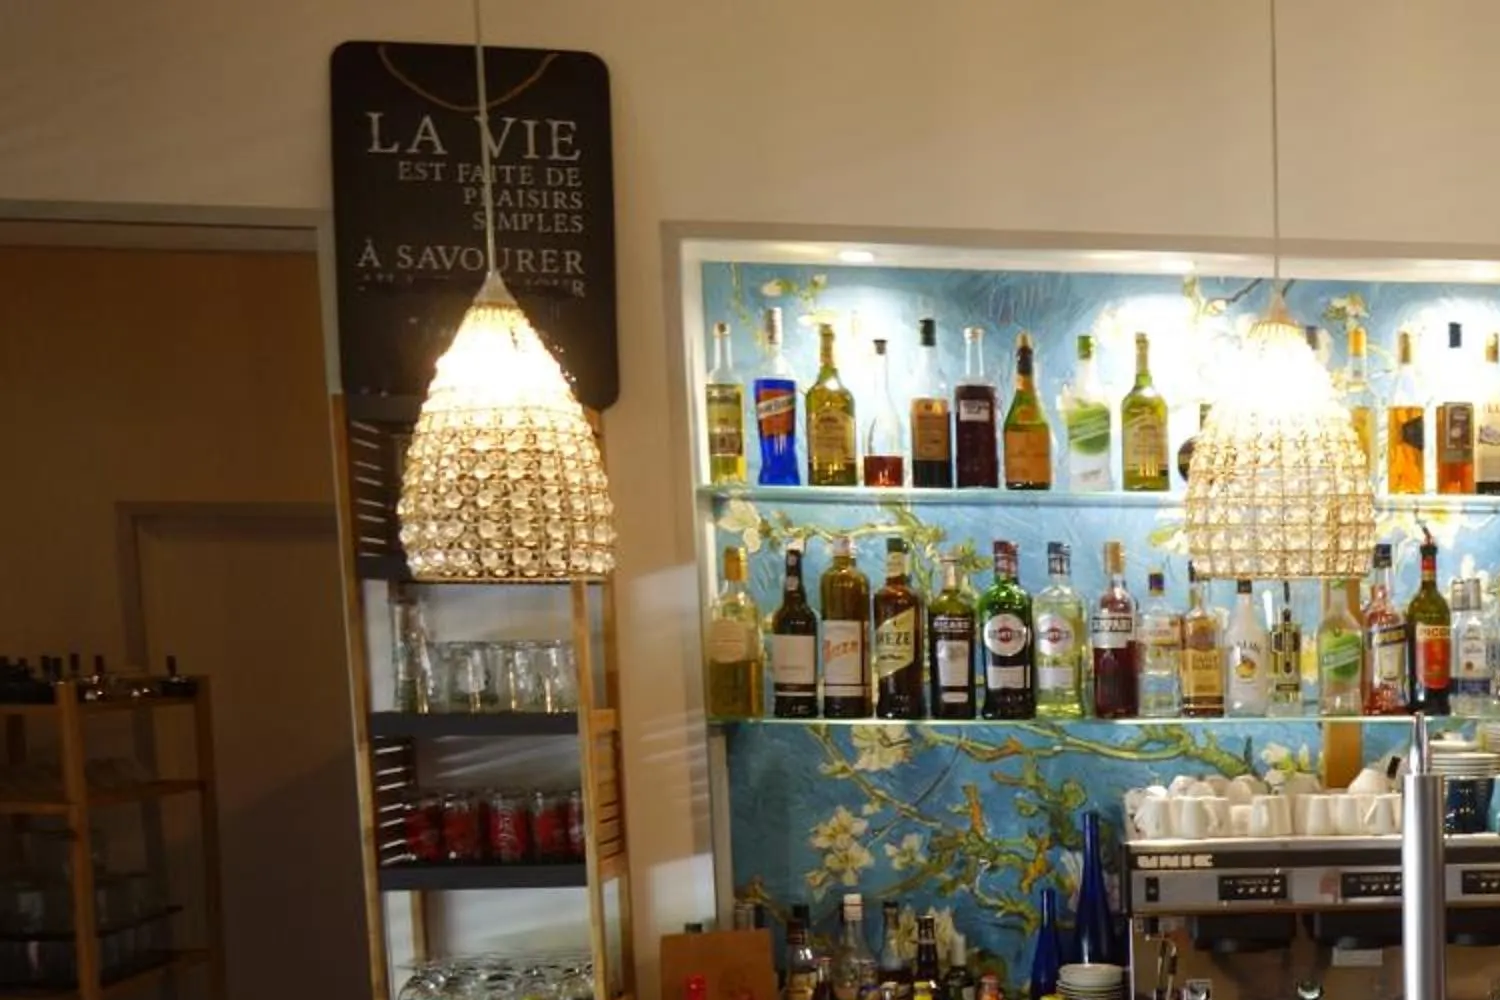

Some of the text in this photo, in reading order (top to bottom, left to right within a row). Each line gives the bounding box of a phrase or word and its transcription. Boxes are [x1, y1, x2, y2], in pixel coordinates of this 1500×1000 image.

[366, 112, 582, 161] LA VIE
[398, 161, 582, 187] EST FAITE DE
[472, 211, 584, 233] SMPLES
[357, 236, 585, 274] À SAVOURER
